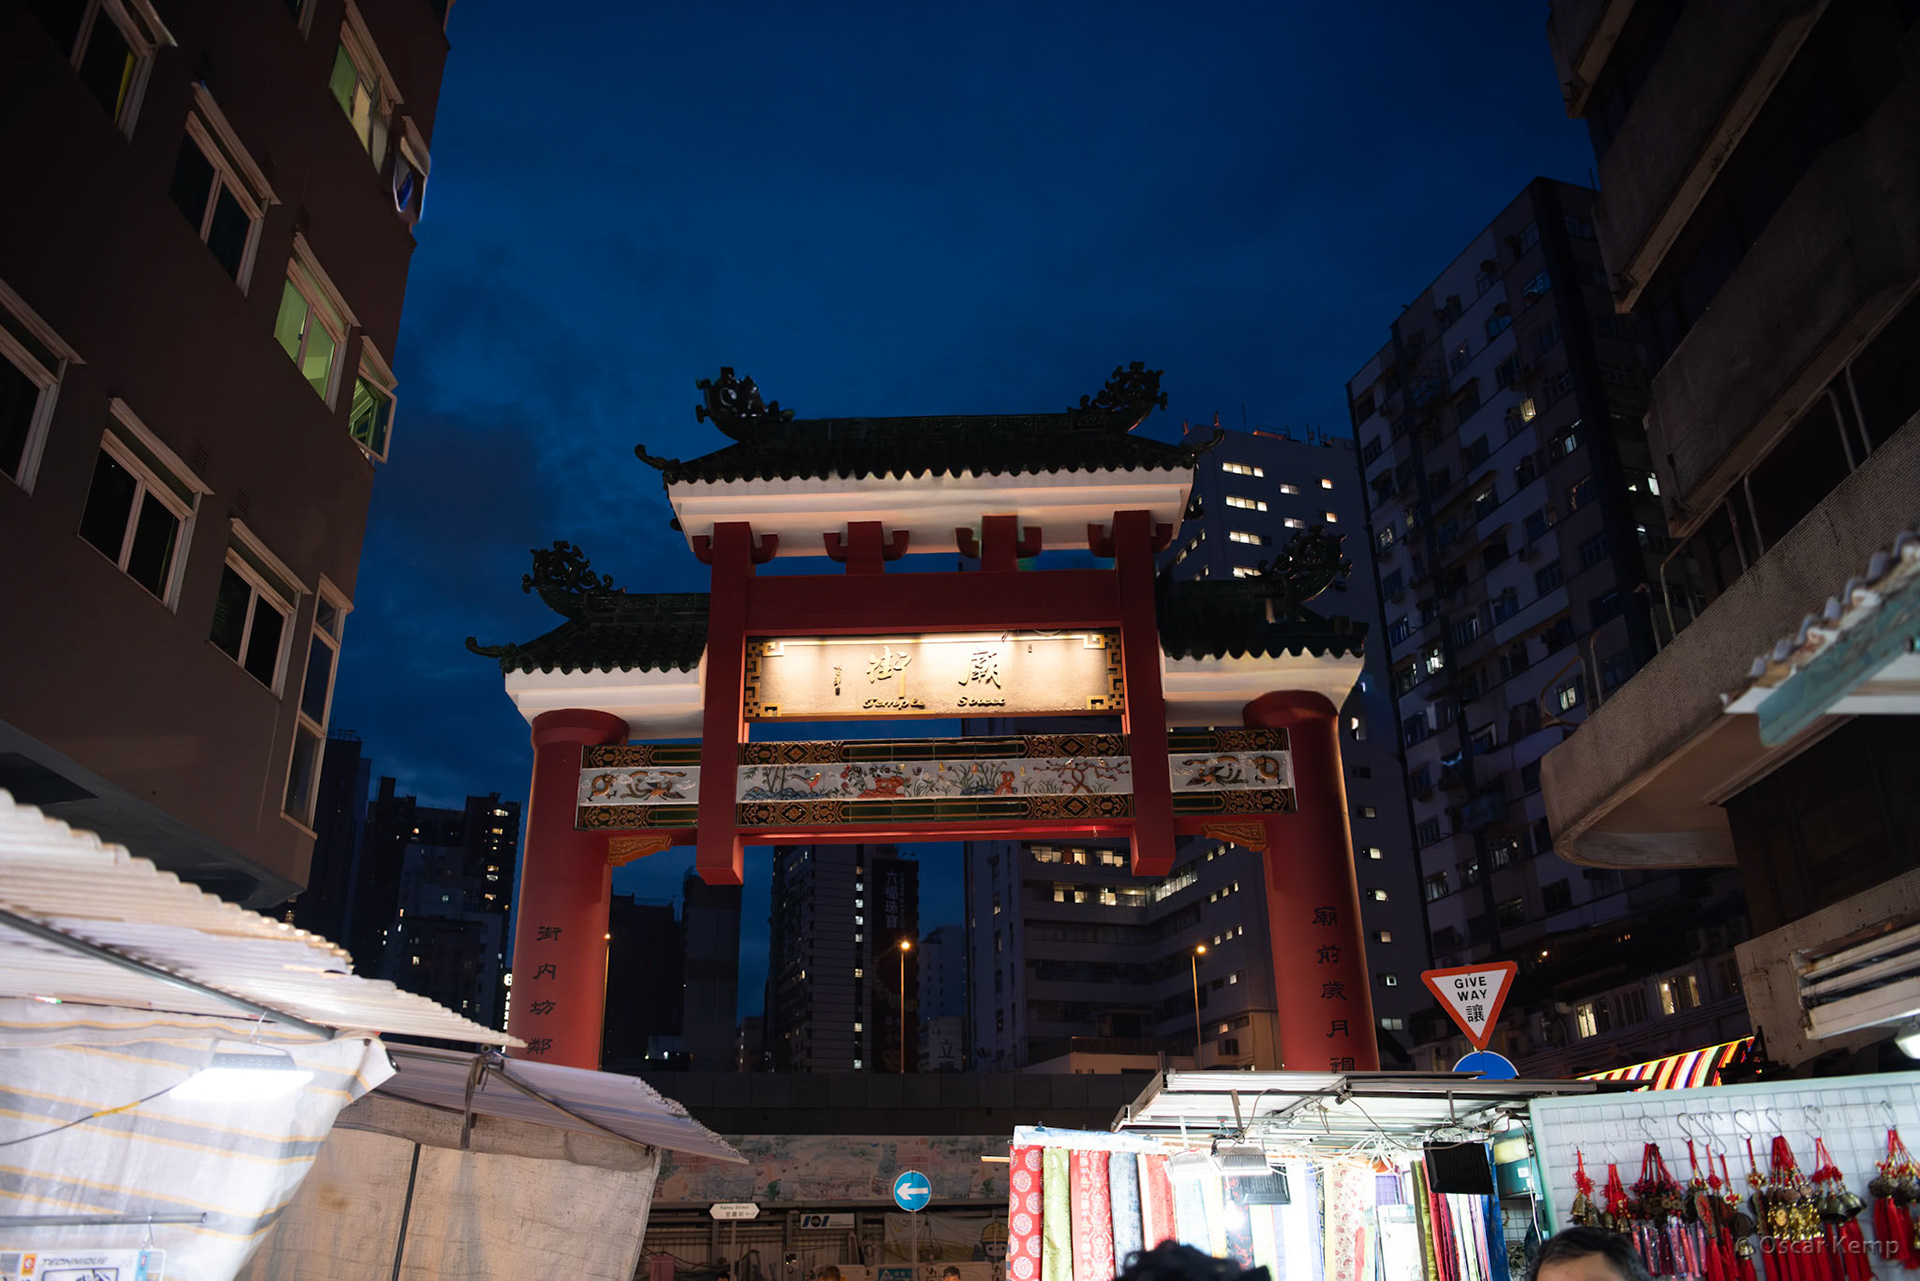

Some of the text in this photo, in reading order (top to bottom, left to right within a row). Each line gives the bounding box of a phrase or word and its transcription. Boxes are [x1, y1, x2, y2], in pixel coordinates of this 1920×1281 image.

[863, 697, 926, 710] Temple
[1454, 976, 1487, 989] GIVE
[1457, 989, 1488, 1002] WAY
[1465, 1004, 1485, 1023] 讓
